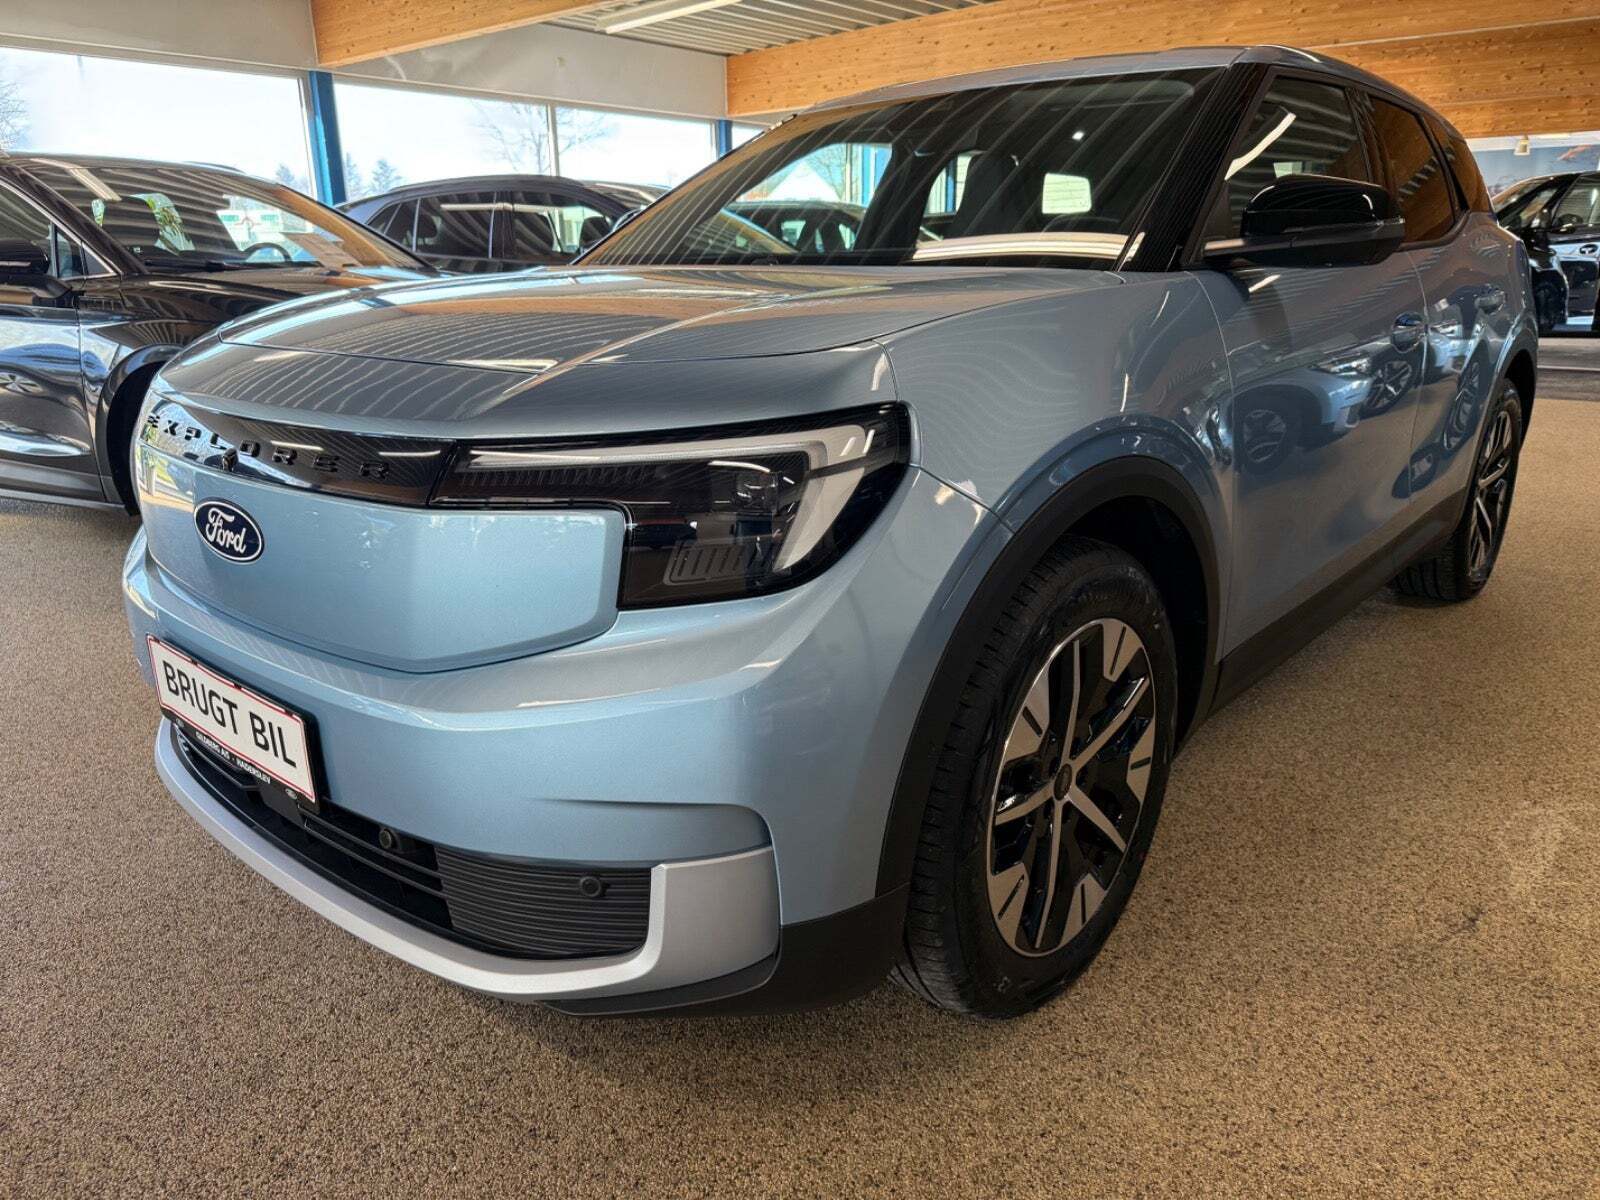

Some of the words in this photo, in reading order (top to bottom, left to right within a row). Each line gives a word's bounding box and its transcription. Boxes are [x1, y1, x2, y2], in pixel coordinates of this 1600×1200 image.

[146, 413, 391, 480] EXPLORER
[205, 506, 247, 555] Ford
[162, 660, 239, 735] BRUGT
[249, 711, 297, 769] BIL
